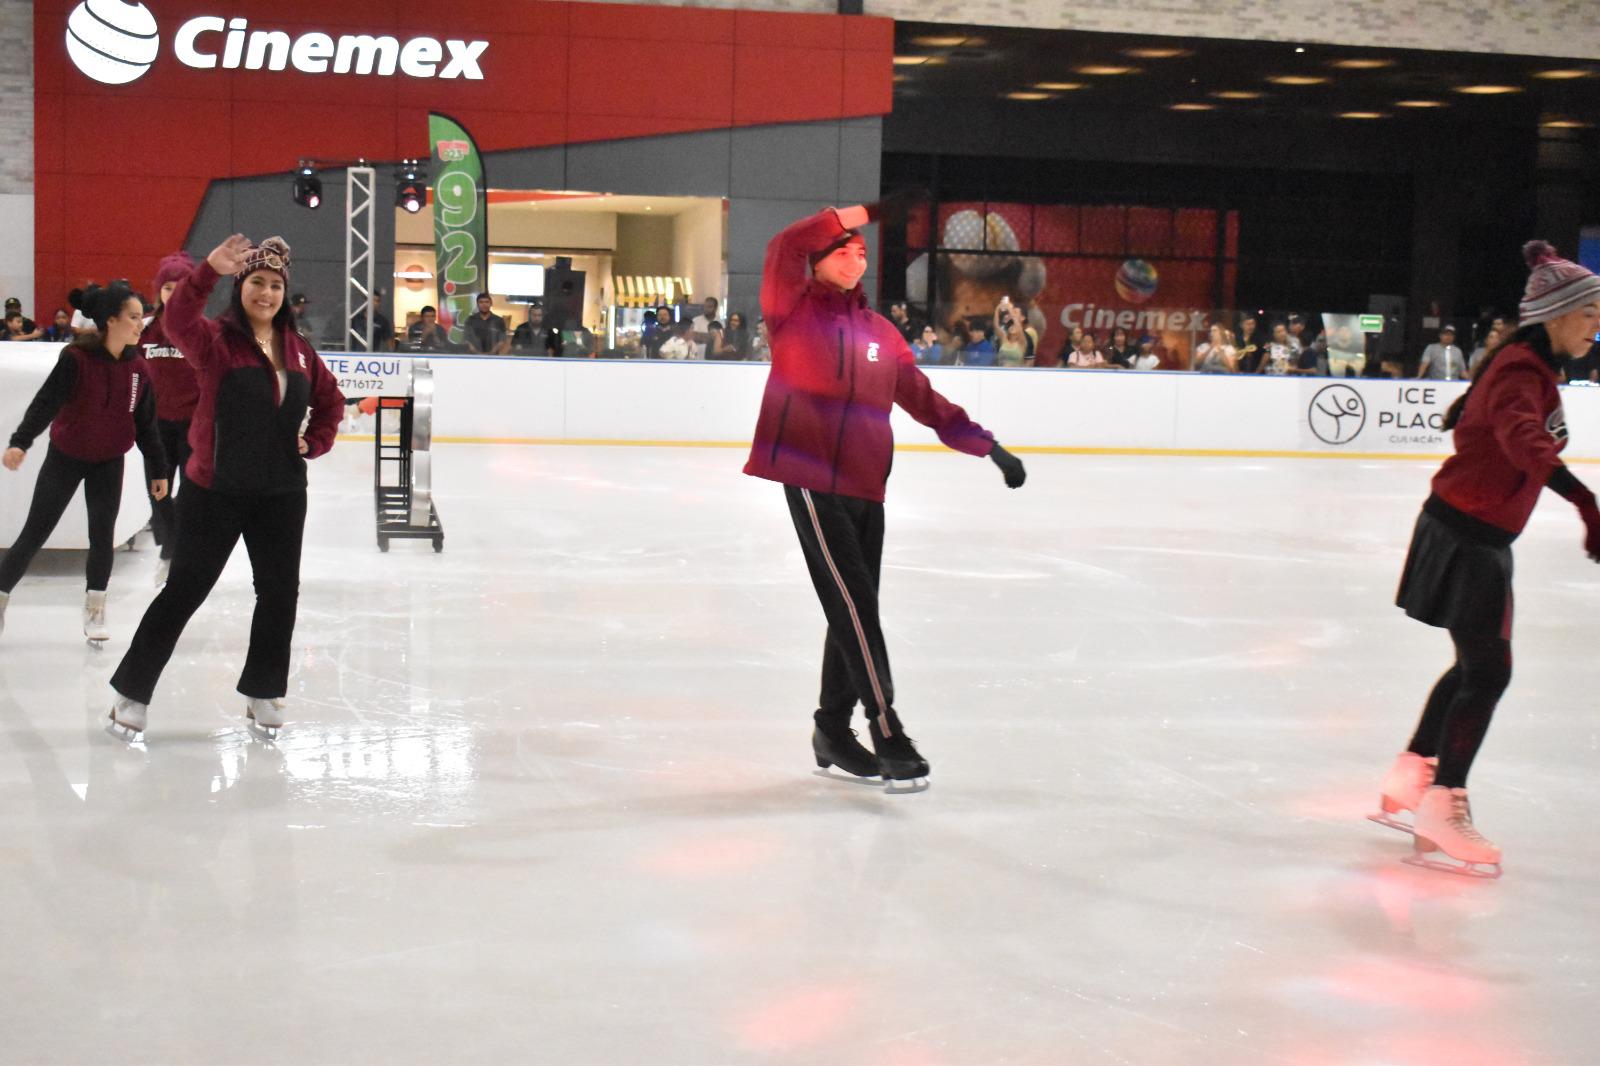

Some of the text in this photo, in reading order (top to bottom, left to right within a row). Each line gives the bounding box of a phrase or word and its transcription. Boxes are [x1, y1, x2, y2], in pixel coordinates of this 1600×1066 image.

[174, 15, 490, 80] Cinemex
[1060, 303, 1208, 332] Cinemex
[327, 359, 350, 373] TE
[354, 359, 401, 377] AQUÍ
[338, 379, 384, 390] 4716172
[1398, 387, 1436, 404] ICE
[1379, 411, 1443, 429] PLAC
